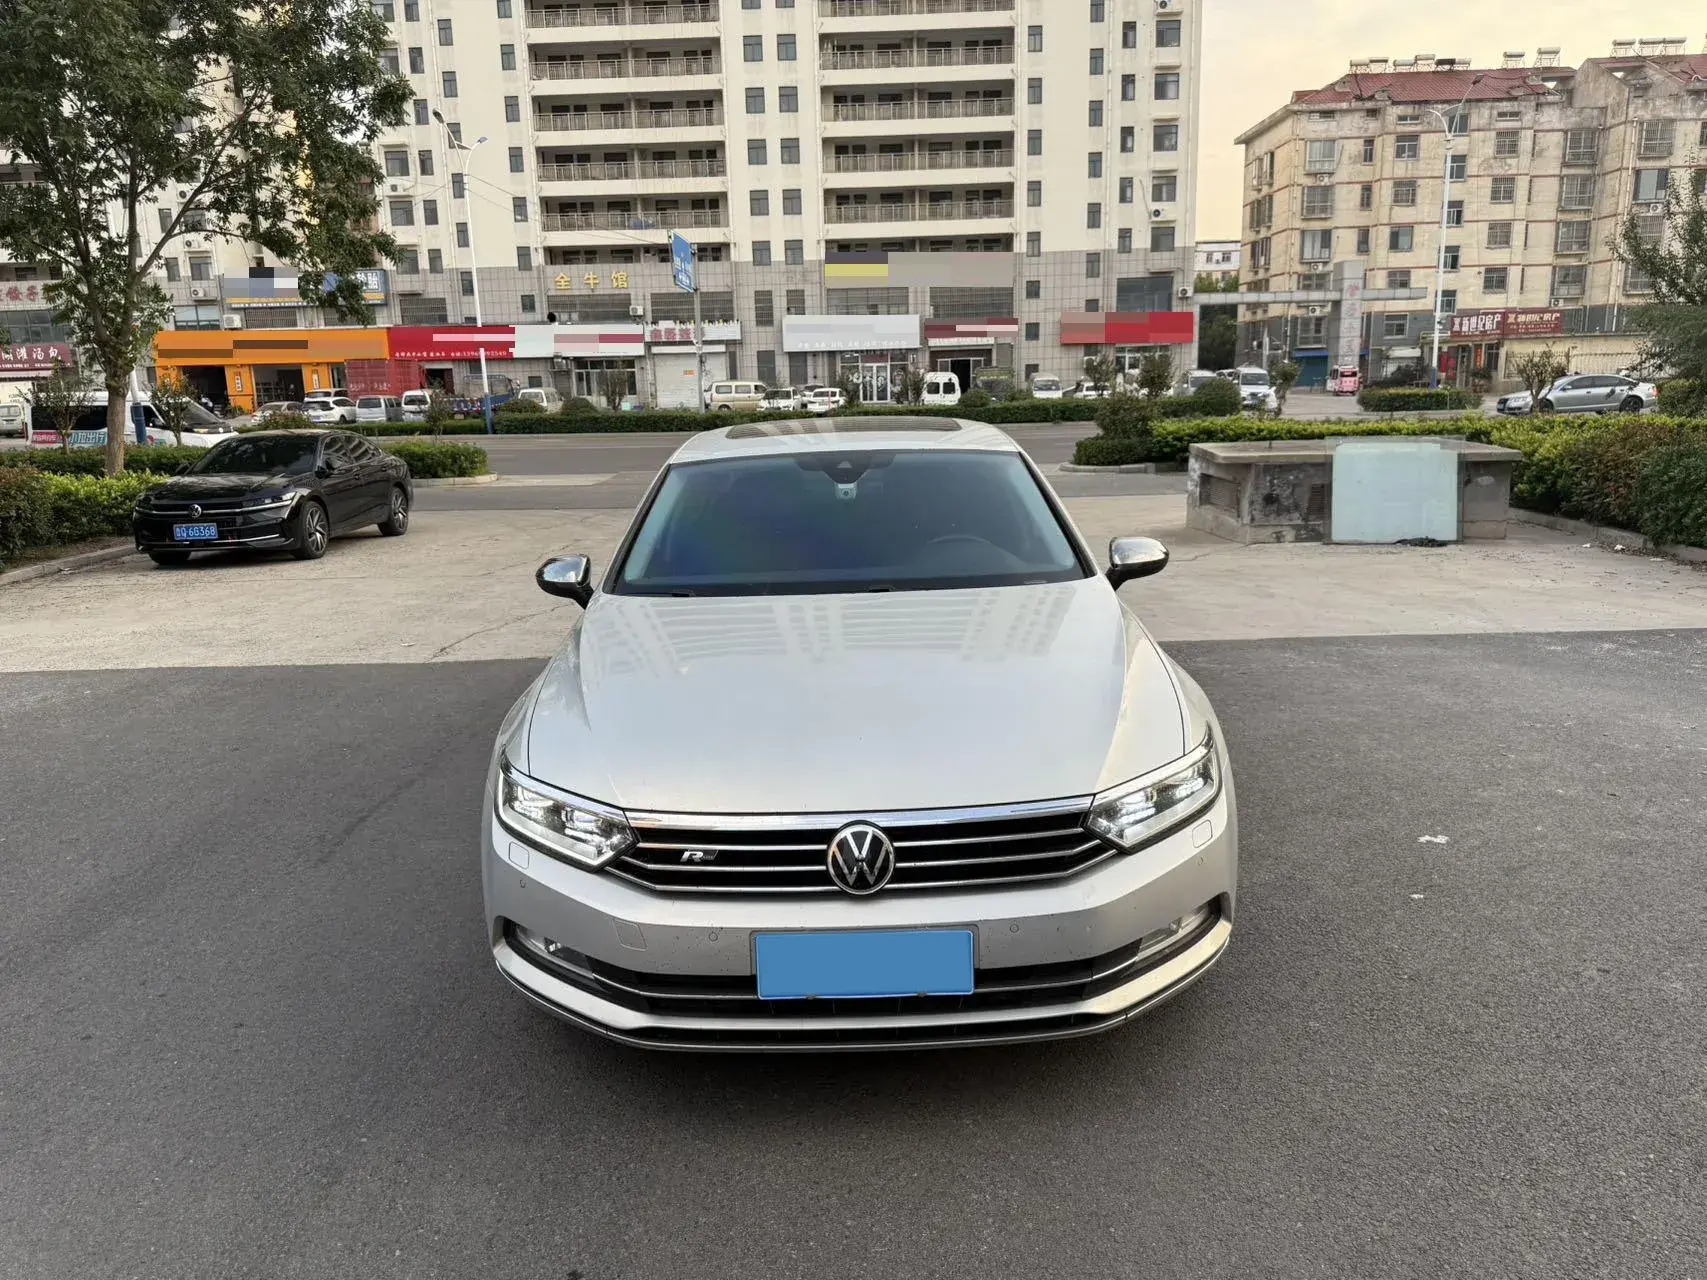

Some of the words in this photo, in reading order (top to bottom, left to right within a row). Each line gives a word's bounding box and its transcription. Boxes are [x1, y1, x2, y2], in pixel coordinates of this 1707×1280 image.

[554, 271, 629, 289] 全牛馆
[1461, 313, 1502, 332] 新世纪房产
